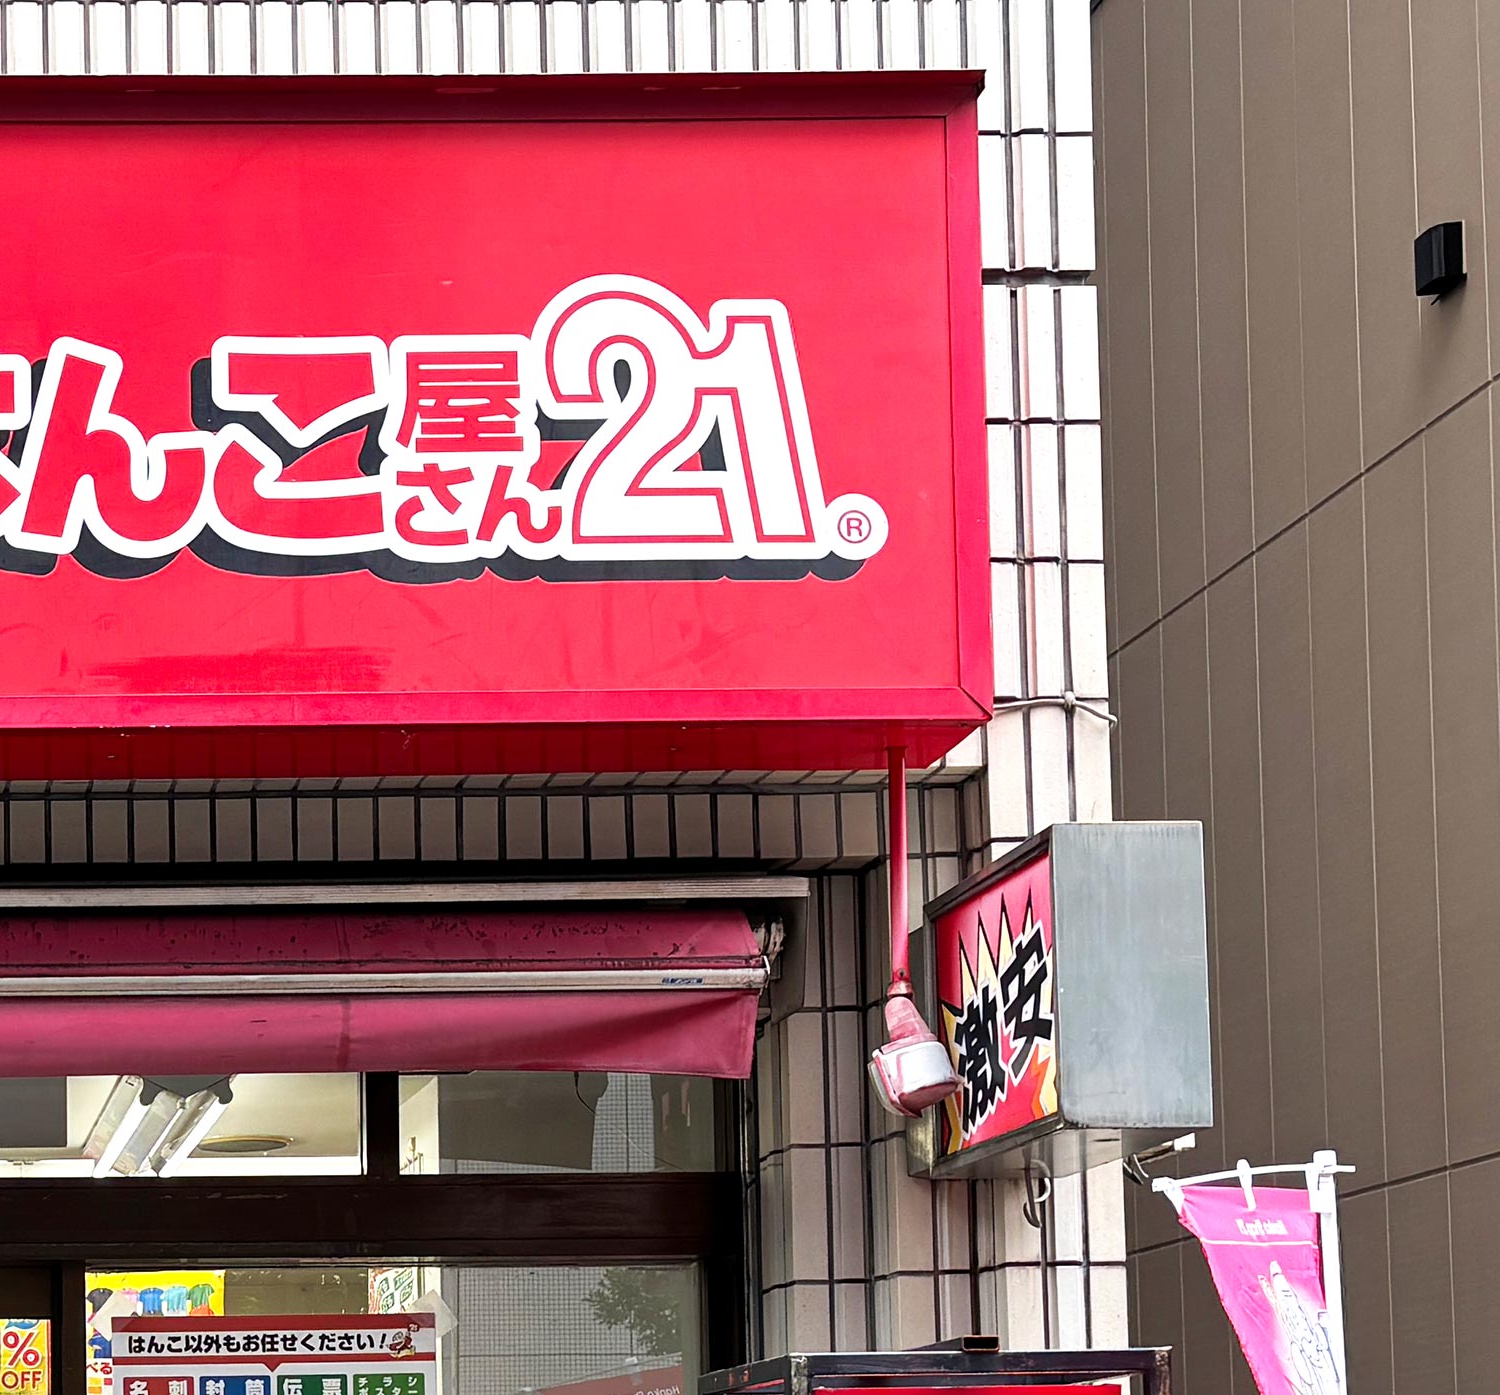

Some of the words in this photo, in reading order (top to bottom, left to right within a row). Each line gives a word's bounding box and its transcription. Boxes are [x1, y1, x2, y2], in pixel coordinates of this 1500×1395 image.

[955, 922, 1053, 1134] 激安
[127, 1332, 387, 1354] はんこ以外もお任せください!
[1, 1371, 42, 1389] OFF
[358, 1376, 418, 1387] チラシ
